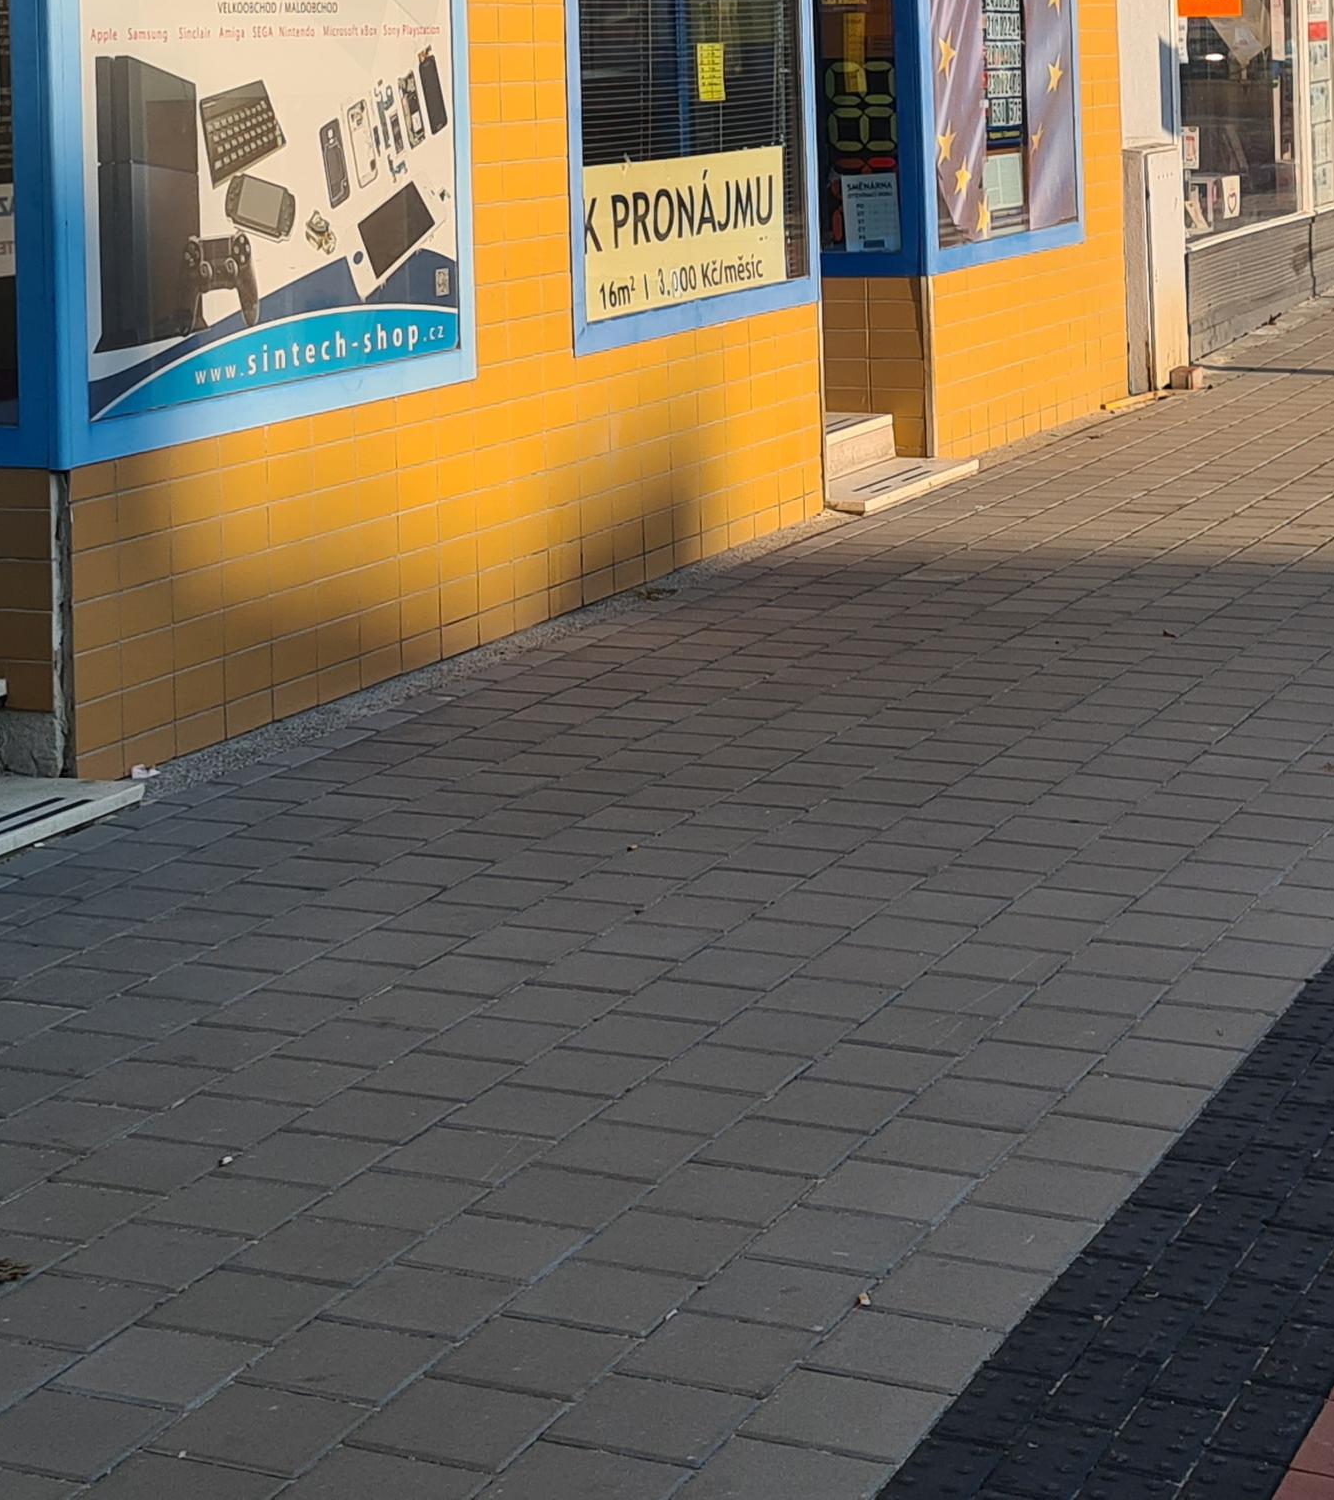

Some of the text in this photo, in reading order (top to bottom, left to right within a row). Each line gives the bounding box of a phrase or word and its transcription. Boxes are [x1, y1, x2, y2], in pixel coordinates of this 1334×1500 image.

[217, 0, 339, 15] VELKOOBCHOD MALOOBCHOD
[89, 28, 118, 43] Apple
[252, 25, 274, 39] SEGA
[584, 197, 603, 255] K
[610, 168, 774, 249] PRONÁJMU
[700, 254, 764, 288] Kč/měsíc
[194, 322, 445, 386] www.sintech-shop.cz
